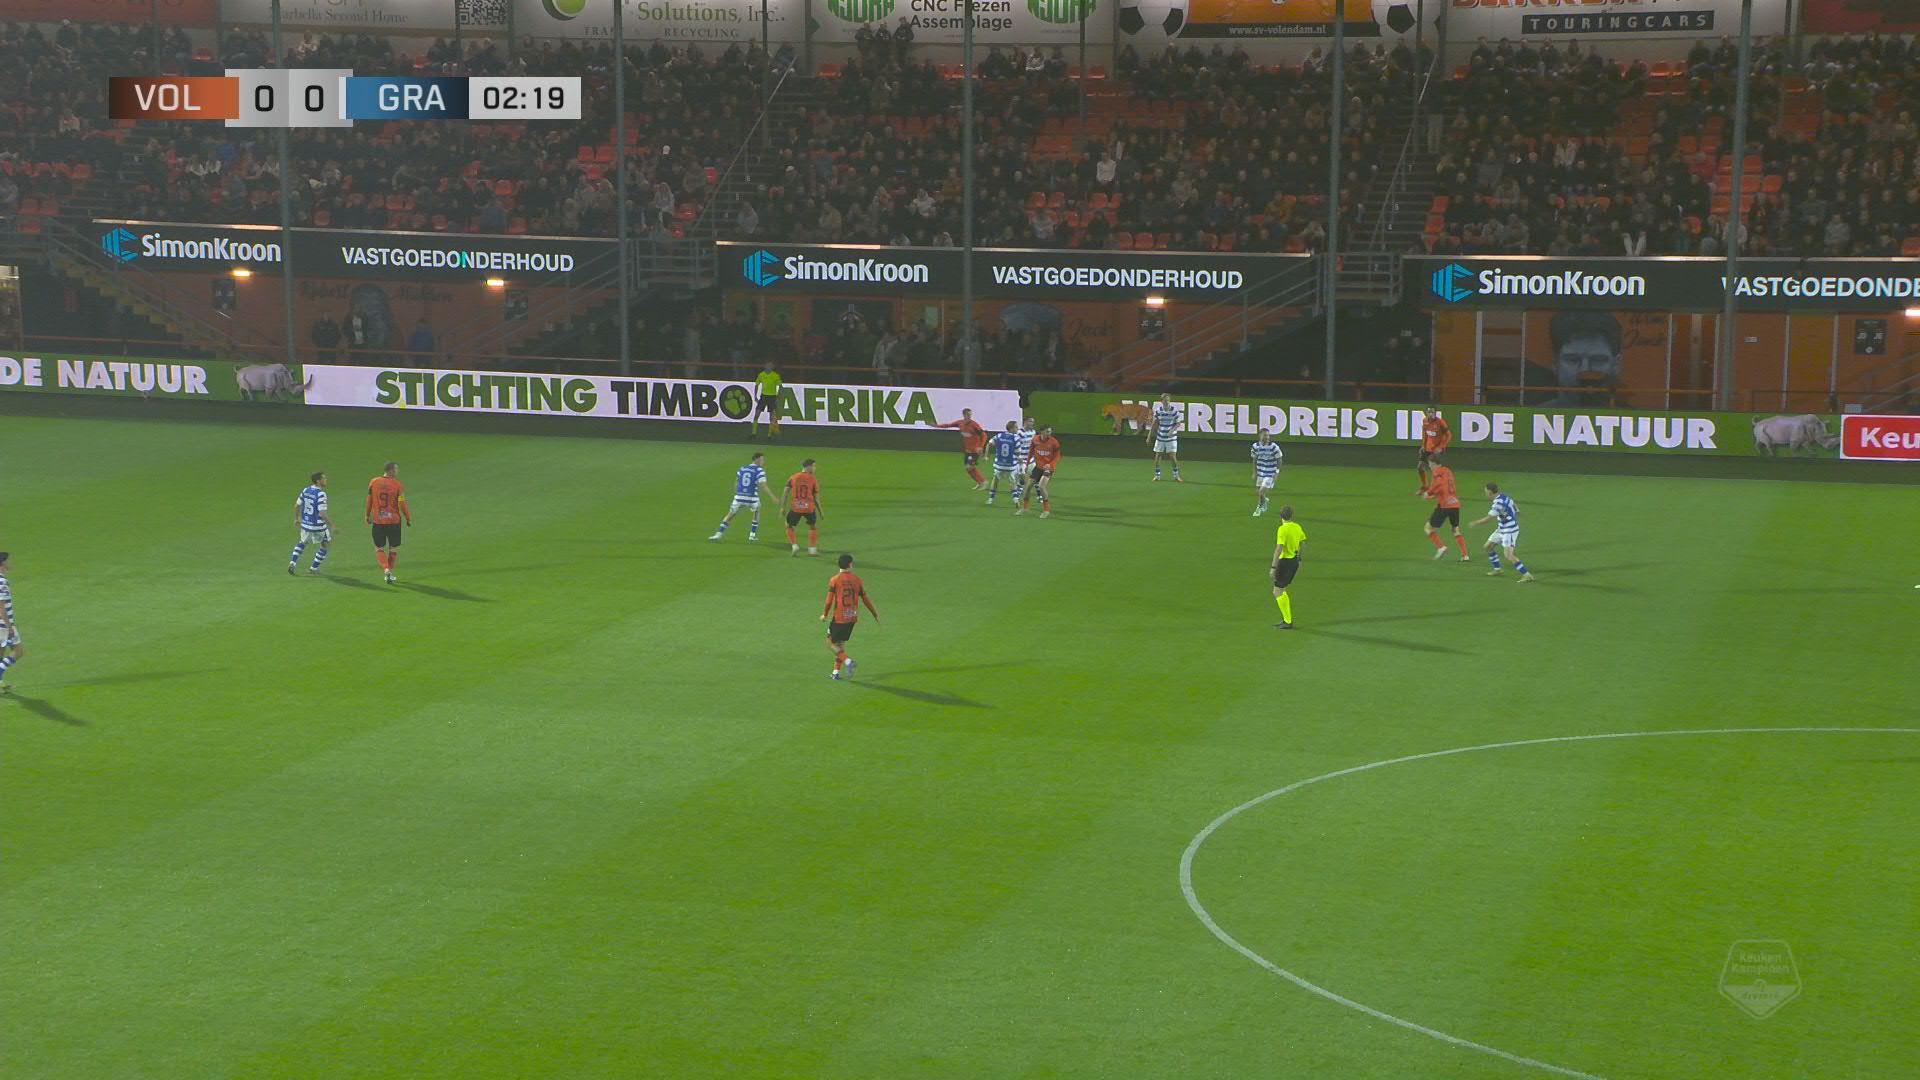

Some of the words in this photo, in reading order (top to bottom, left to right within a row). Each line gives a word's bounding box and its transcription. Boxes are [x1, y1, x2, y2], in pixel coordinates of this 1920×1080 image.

[271, 7, 321, 20] arbella
[637, 1, 741, 23] Solutions,
[911, 0, 948, 11] CNC
[954, 0, 1011, 12] Fezen
[664, 27, 740, 38] RECYCLING
[911, 15, 1012, 31] Assemlage
[1530, 14, 1707, 31] TOURINGCARS
[142, 233, 282, 262] SimonKroon
[341, 247, 575, 272] VASTGOEDONDERHOUD
[784, 255, 929, 283] SimonKroon
[993, 266, 1243, 290] VASTGOEDONDERHOUD
[1478, 268, 1646, 296] SimonKroon
[0, 357, 43, 387] DE
[58, 360, 209, 395] NATUUR
[376, 371, 598, 413] STICHTING
[611, 381, 753, 420] TIMBO
[777, 387, 938, 425] AFRIKA
[1460, 412, 1514, 443] DE
[1533, 414, 1718, 449] NATUUR
[1861, 427, 1920, 449] Keu
[1000, 443, 1010, 457] 8
[741, 472, 752, 487] 6
